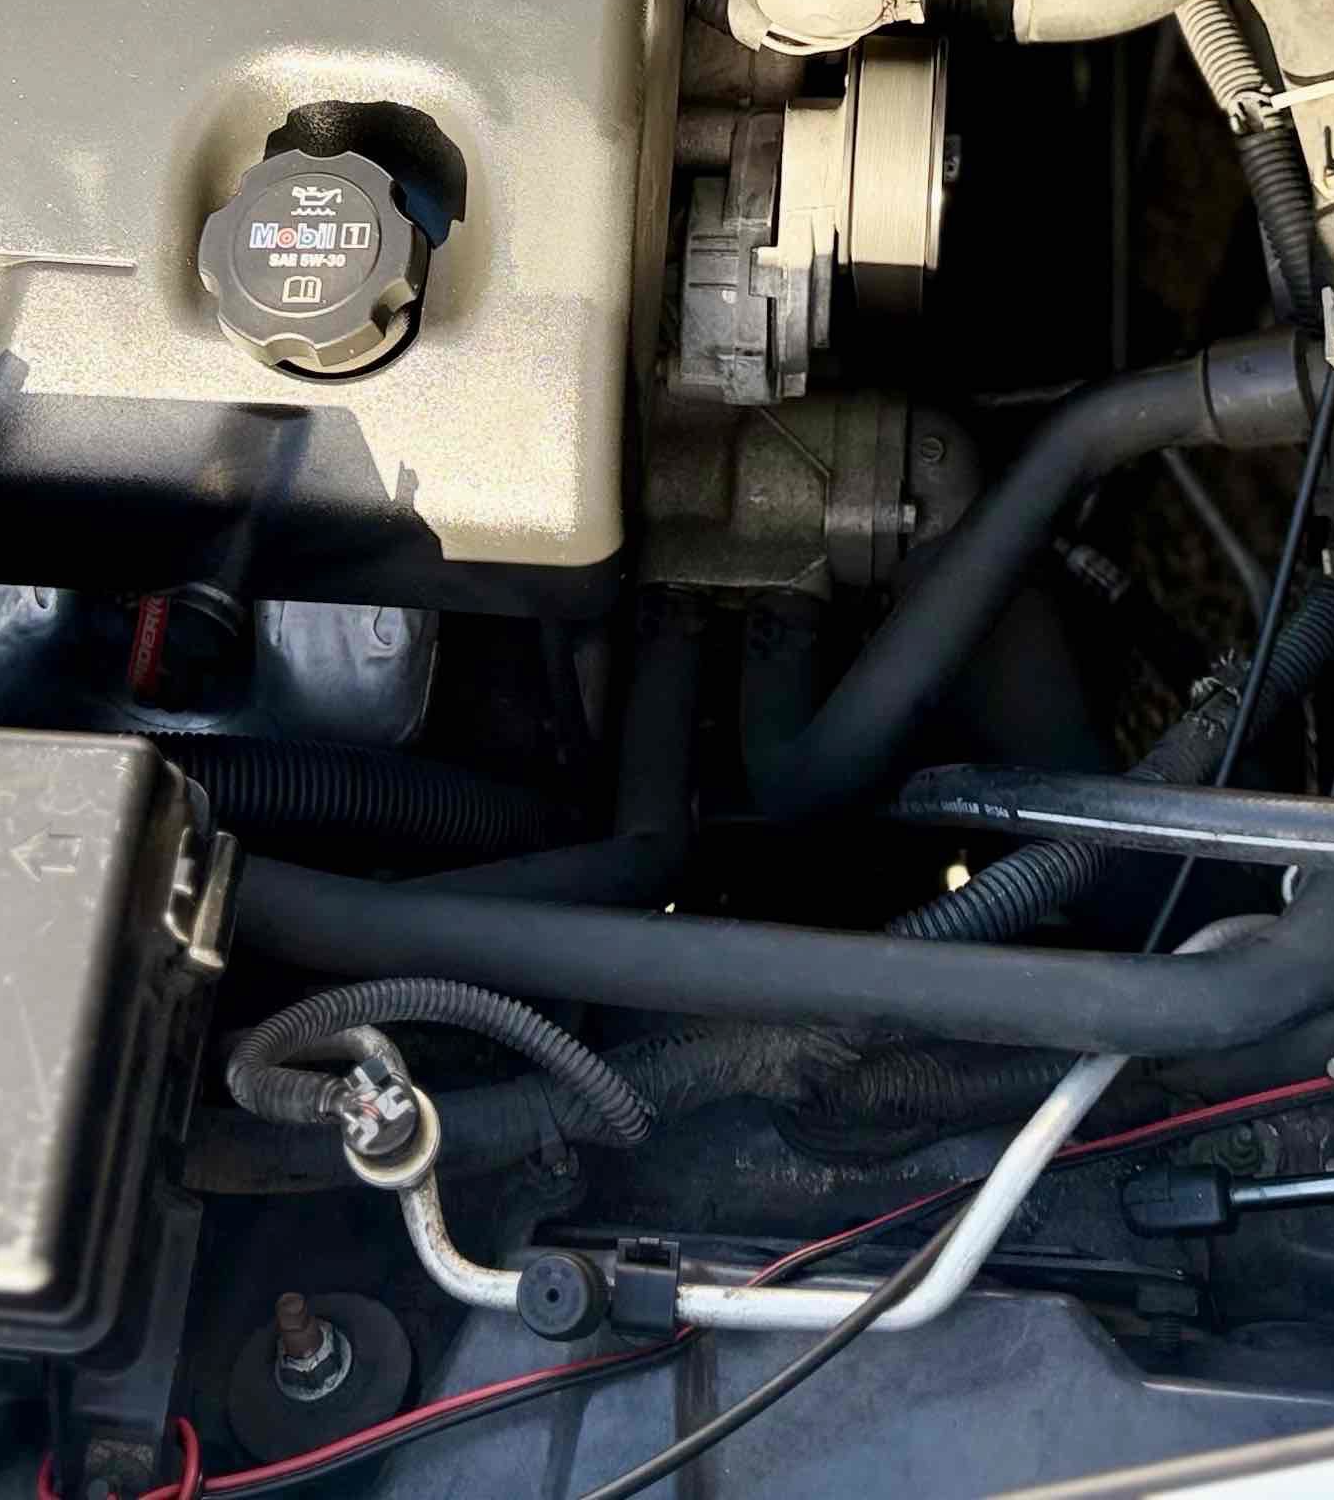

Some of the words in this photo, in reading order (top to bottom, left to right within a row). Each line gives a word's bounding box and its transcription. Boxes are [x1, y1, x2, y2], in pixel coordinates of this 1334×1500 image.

[249, 221, 337, 250] Mobil
[268, 252, 298, 268] SAE
[299, 252, 347, 268] 5W-30
